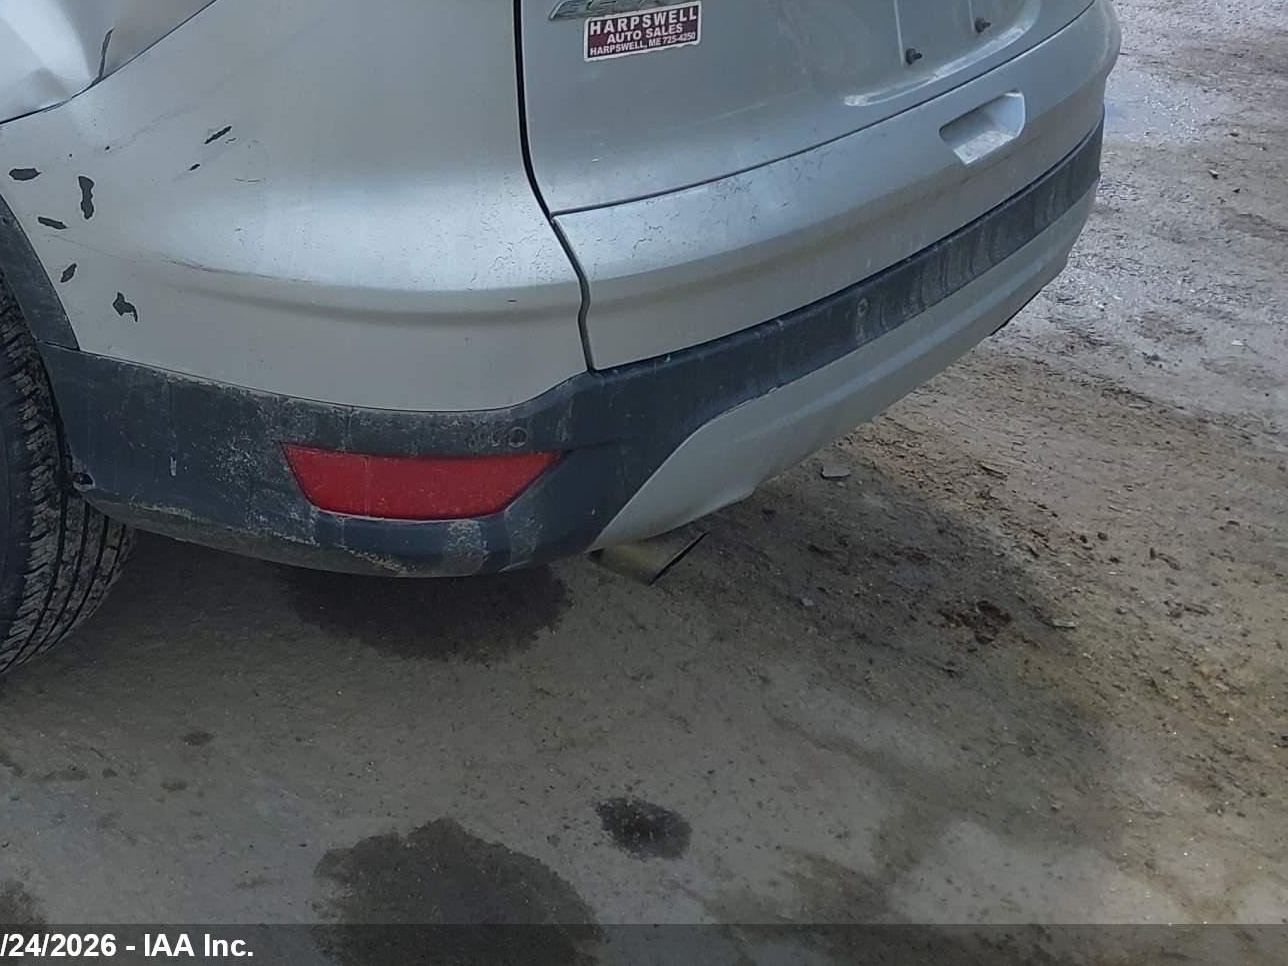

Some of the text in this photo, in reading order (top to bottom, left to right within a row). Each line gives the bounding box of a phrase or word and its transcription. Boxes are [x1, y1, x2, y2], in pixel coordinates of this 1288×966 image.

[589, 7, 698, 36] HARPSWELL
[606, 22, 684, 45] AUTO SALES
[589, 40, 648, 57] HARPSWELL,
[648, 37, 662, 47] ME
